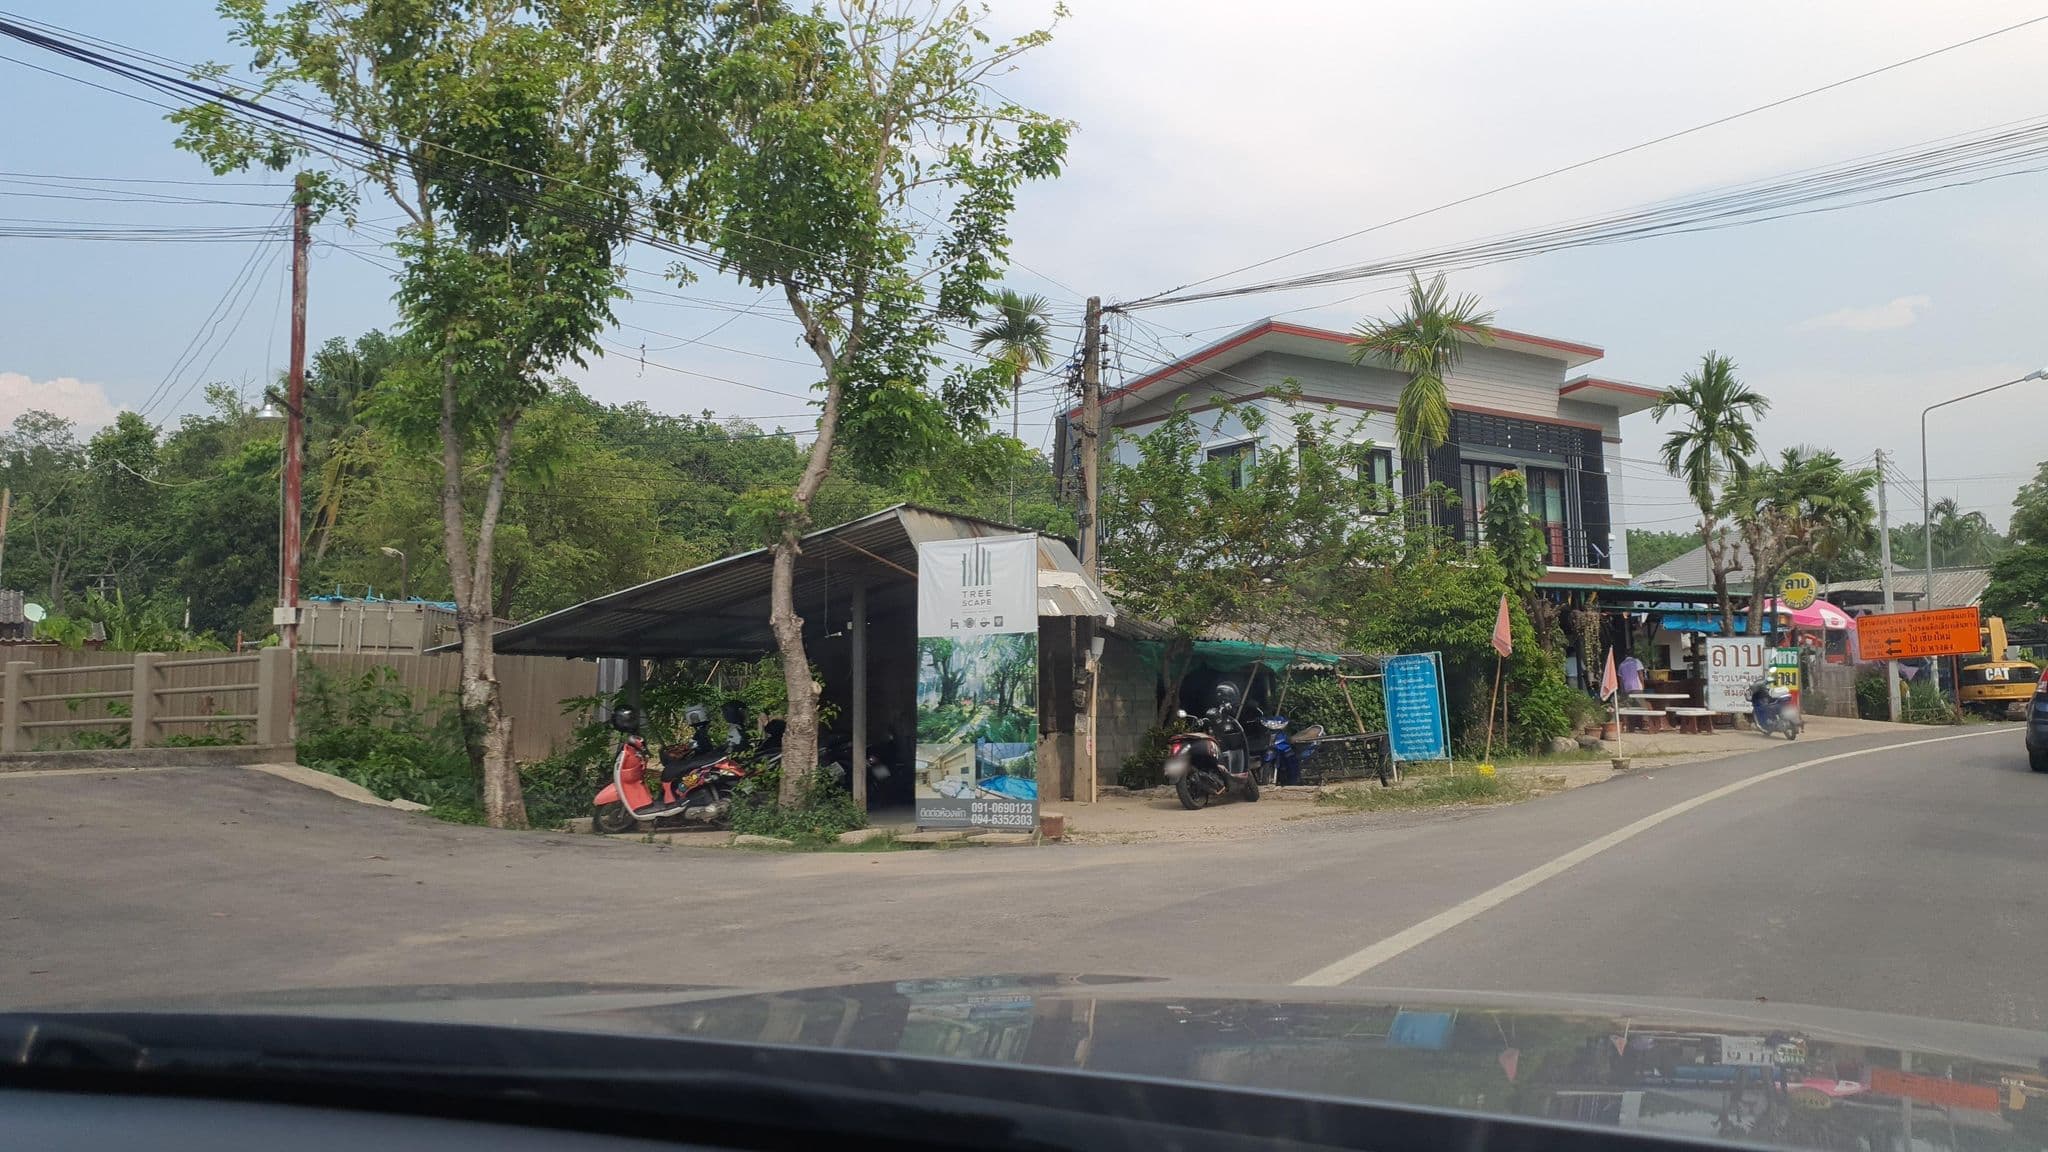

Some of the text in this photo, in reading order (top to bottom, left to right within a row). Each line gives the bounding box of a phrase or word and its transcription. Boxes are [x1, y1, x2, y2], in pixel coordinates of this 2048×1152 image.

[1785, 578, 1810, 590] ลาบ
[962, 589, 992, 598] TREE
[962, 599, 992, 607] SCAPE
[1920, 632, 1951, 642] เชียงใหม่
[1711, 644, 1762, 667] ลาบ
[1985, 667, 2010, 681] CAT
[971, 803, 1033, 814] 091-0690123
[971, 814, 1033, 825] 094-6352303
